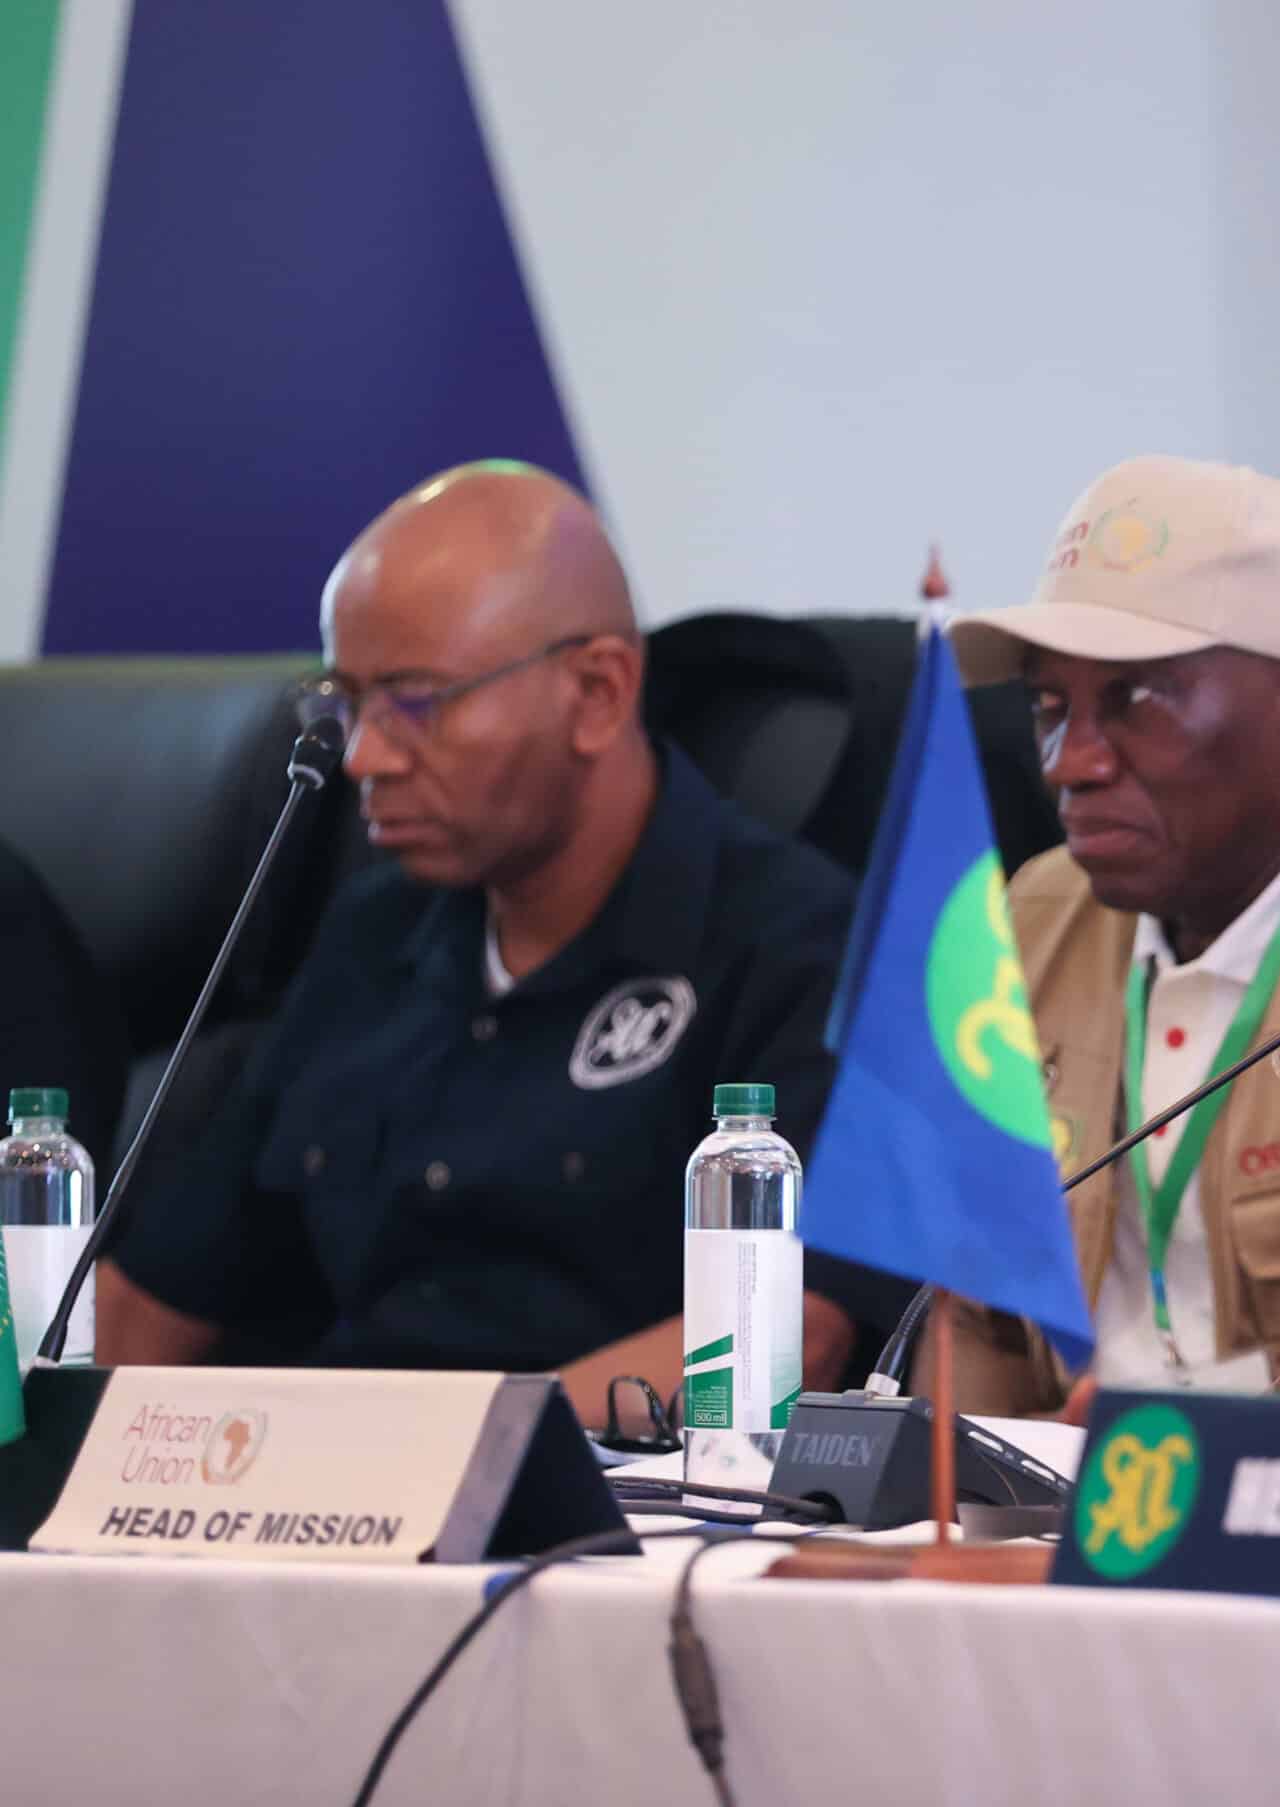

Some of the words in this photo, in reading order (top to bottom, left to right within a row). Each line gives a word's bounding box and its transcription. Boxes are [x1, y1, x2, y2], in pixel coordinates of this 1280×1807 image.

[122, 1403, 212, 1442] African
[121, 1445, 195, 1485] Union
[791, 1432, 876, 1468] TAIDEN
[100, 1507, 197, 1540] HEAD
[203, 1511, 252, 1542] OF
[255, 1513, 401, 1546] MISSION
